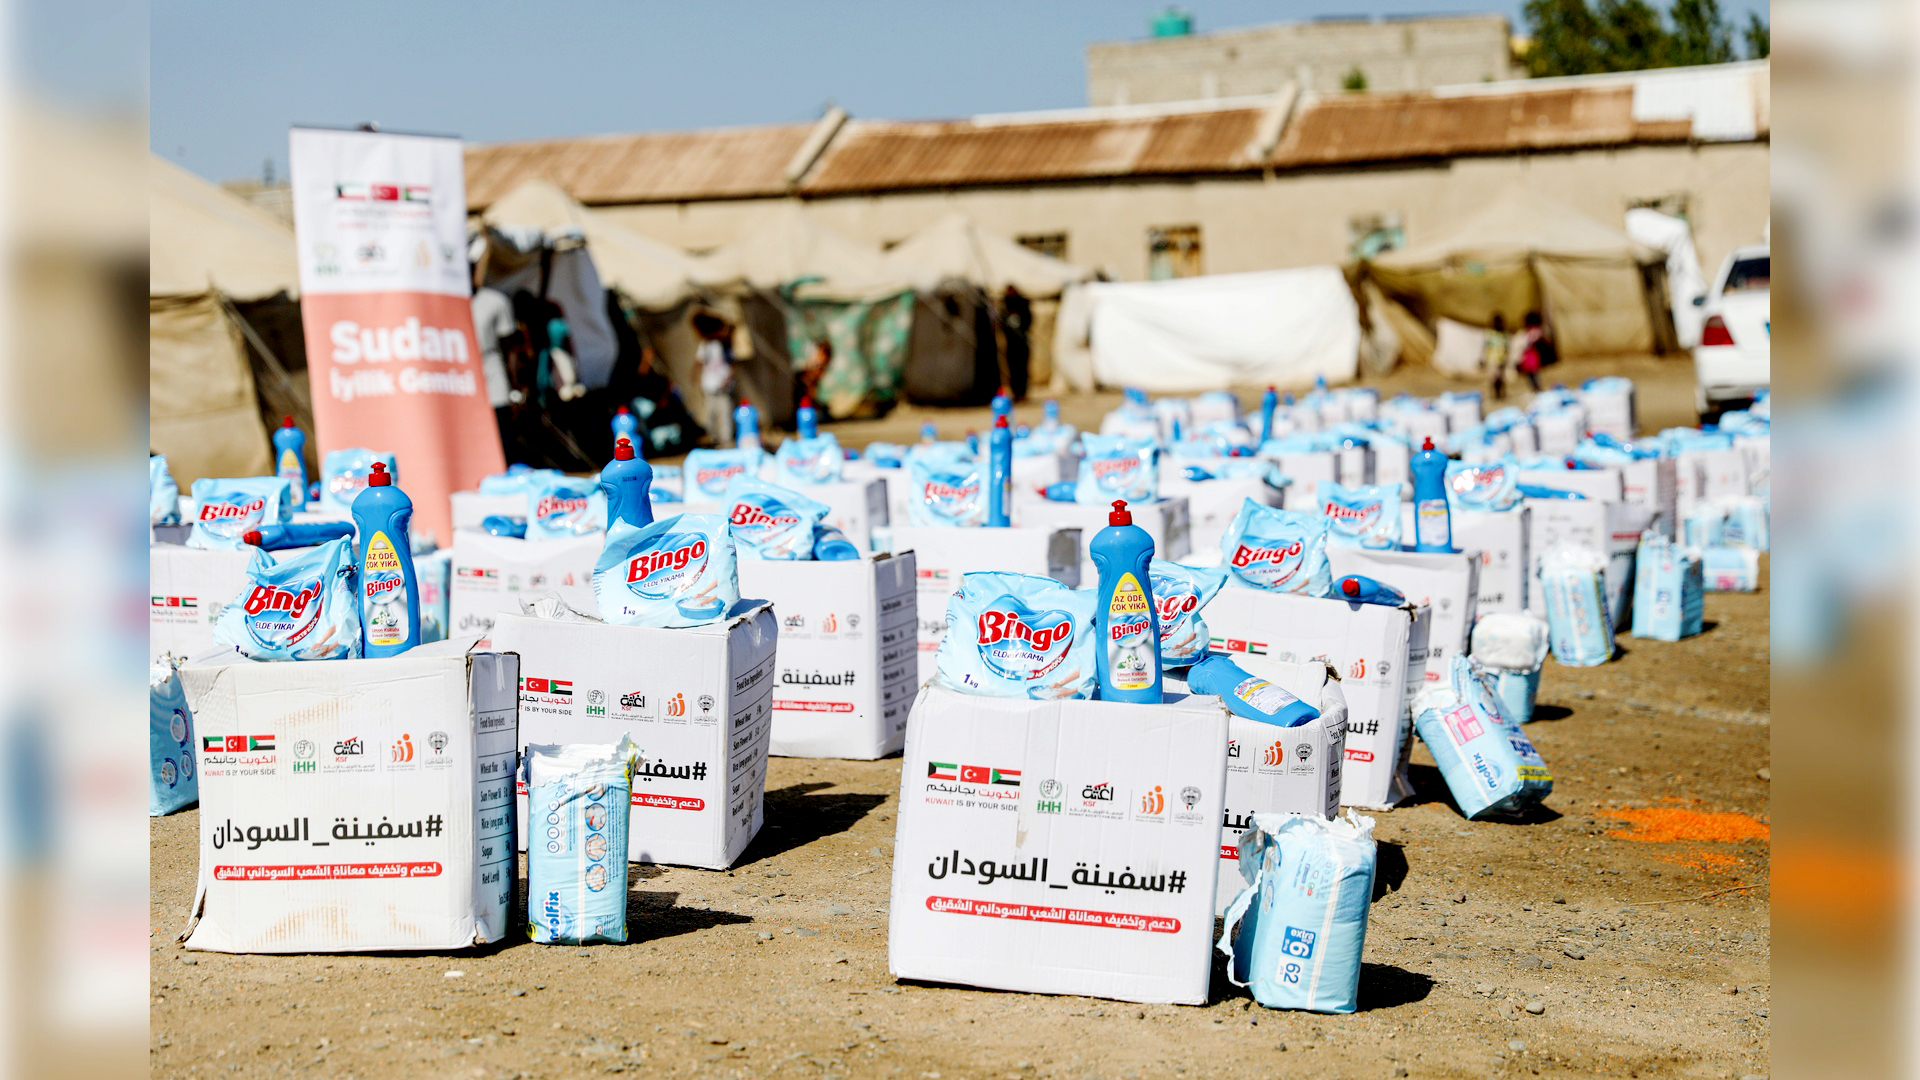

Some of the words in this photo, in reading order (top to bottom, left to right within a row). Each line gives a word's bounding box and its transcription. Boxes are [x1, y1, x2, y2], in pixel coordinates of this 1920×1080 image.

[329, 315, 469, 364] Sudan
[198, 498, 265, 521] Bingo
[536, 497, 588, 519] Bingo
[1324, 501, 1382, 520] Bingo
[730, 503, 799, 528] Bingo
[378, 552, 394, 560] ÖDE
[1231, 542, 1303, 568] Bingo
[366, 561, 379, 569] ÇOK
[626, 541, 706, 584] Bingo
[660, 572, 685, 584] YIKAMA
[366, 578, 401, 597] Bingo
[1127, 594, 1142, 602] ÖDE
[623, 606, 628, 615] 1
[1112, 603, 1126, 612] ÇOK
[1128, 602, 1146, 610] YIKA
[977, 611, 1071, 652] Bingo
[1112, 620, 1149, 640] Bingo
[992, 650, 1011, 659] ELD
[1015, 652, 1044, 662] KAMA
[963, 674, 970, 684] 1
[970, 680, 979, 689] kg
[1238, 682, 1249, 695] Bingo
[541, 696, 572, 705] الكويت
[586, 704, 606, 716] iHH
[204, 755, 237, 766] بجانبكم
[239, 755, 276, 766] الكويت
[293, 761, 316, 772] iHH
[1474, 752, 1497, 788] molfix
[926, 783, 976, 796] بجانبكم
[978, 788, 1020, 800] الكويت
[645, 797, 677, 808] وتخفيف
[680, 800, 701, 808] لدعم
[925, 797, 955, 806] KUWAIT
[966, 800, 976, 808] BY
[978, 802, 998, 810] YOUR
[1000, 803, 1018, 812] SIDE
[1037, 800, 1062, 812] iHH
[213, 814, 443, 850] #سفينة_السودان
[482, 845, 493, 860] Sugar
[216, 866, 245, 880] الشقيق
[247, 866, 294, 878] السوداني
[297, 865, 330, 878] الشعب
[333, 864, 366, 876] معاناة
[368, 864, 408, 878] وتخفيف
[410, 862, 437, 877] لدعم
[928, 850, 1188, 895] #سفينة_السودان
[931, 898, 973, 912] الشقيق
[975, 902, 1028, 918] السوداني
[545, 891, 560, 940] molfix
[1030, 906, 1066, 921] الشعب
[1068, 911, 1102, 924] معاناة
[1105, 915, 1147, 930] وتخفيف
[1149, 919, 1176, 931] لدعم
[1291, 929, 1314, 940] extra
[1290, 941, 1310, 957] 6
[1284, 962, 1301, 984] 62
